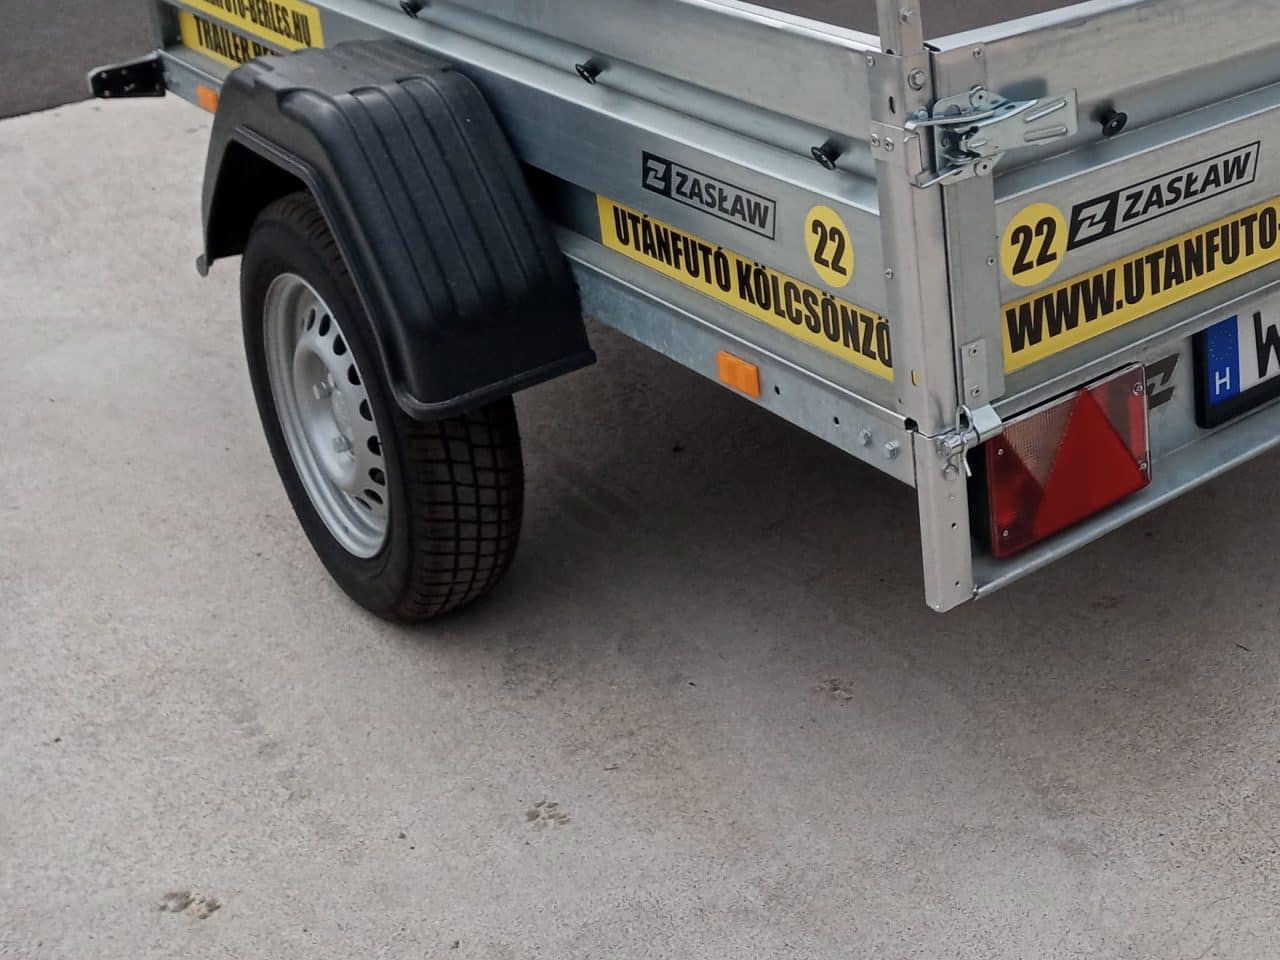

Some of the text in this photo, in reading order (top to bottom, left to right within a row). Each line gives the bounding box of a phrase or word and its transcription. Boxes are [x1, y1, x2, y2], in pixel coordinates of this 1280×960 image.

[675, 171, 770, 230] ZASŁAW
[1121, 150, 1252, 223] ZASŁAW
[612, 205, 732, 292] UTÁNFUTÓ
[811, 219, 848, 276] 22
[1010, 216, 1057, 276] 22
[1214, 367, 1231, 396] H
